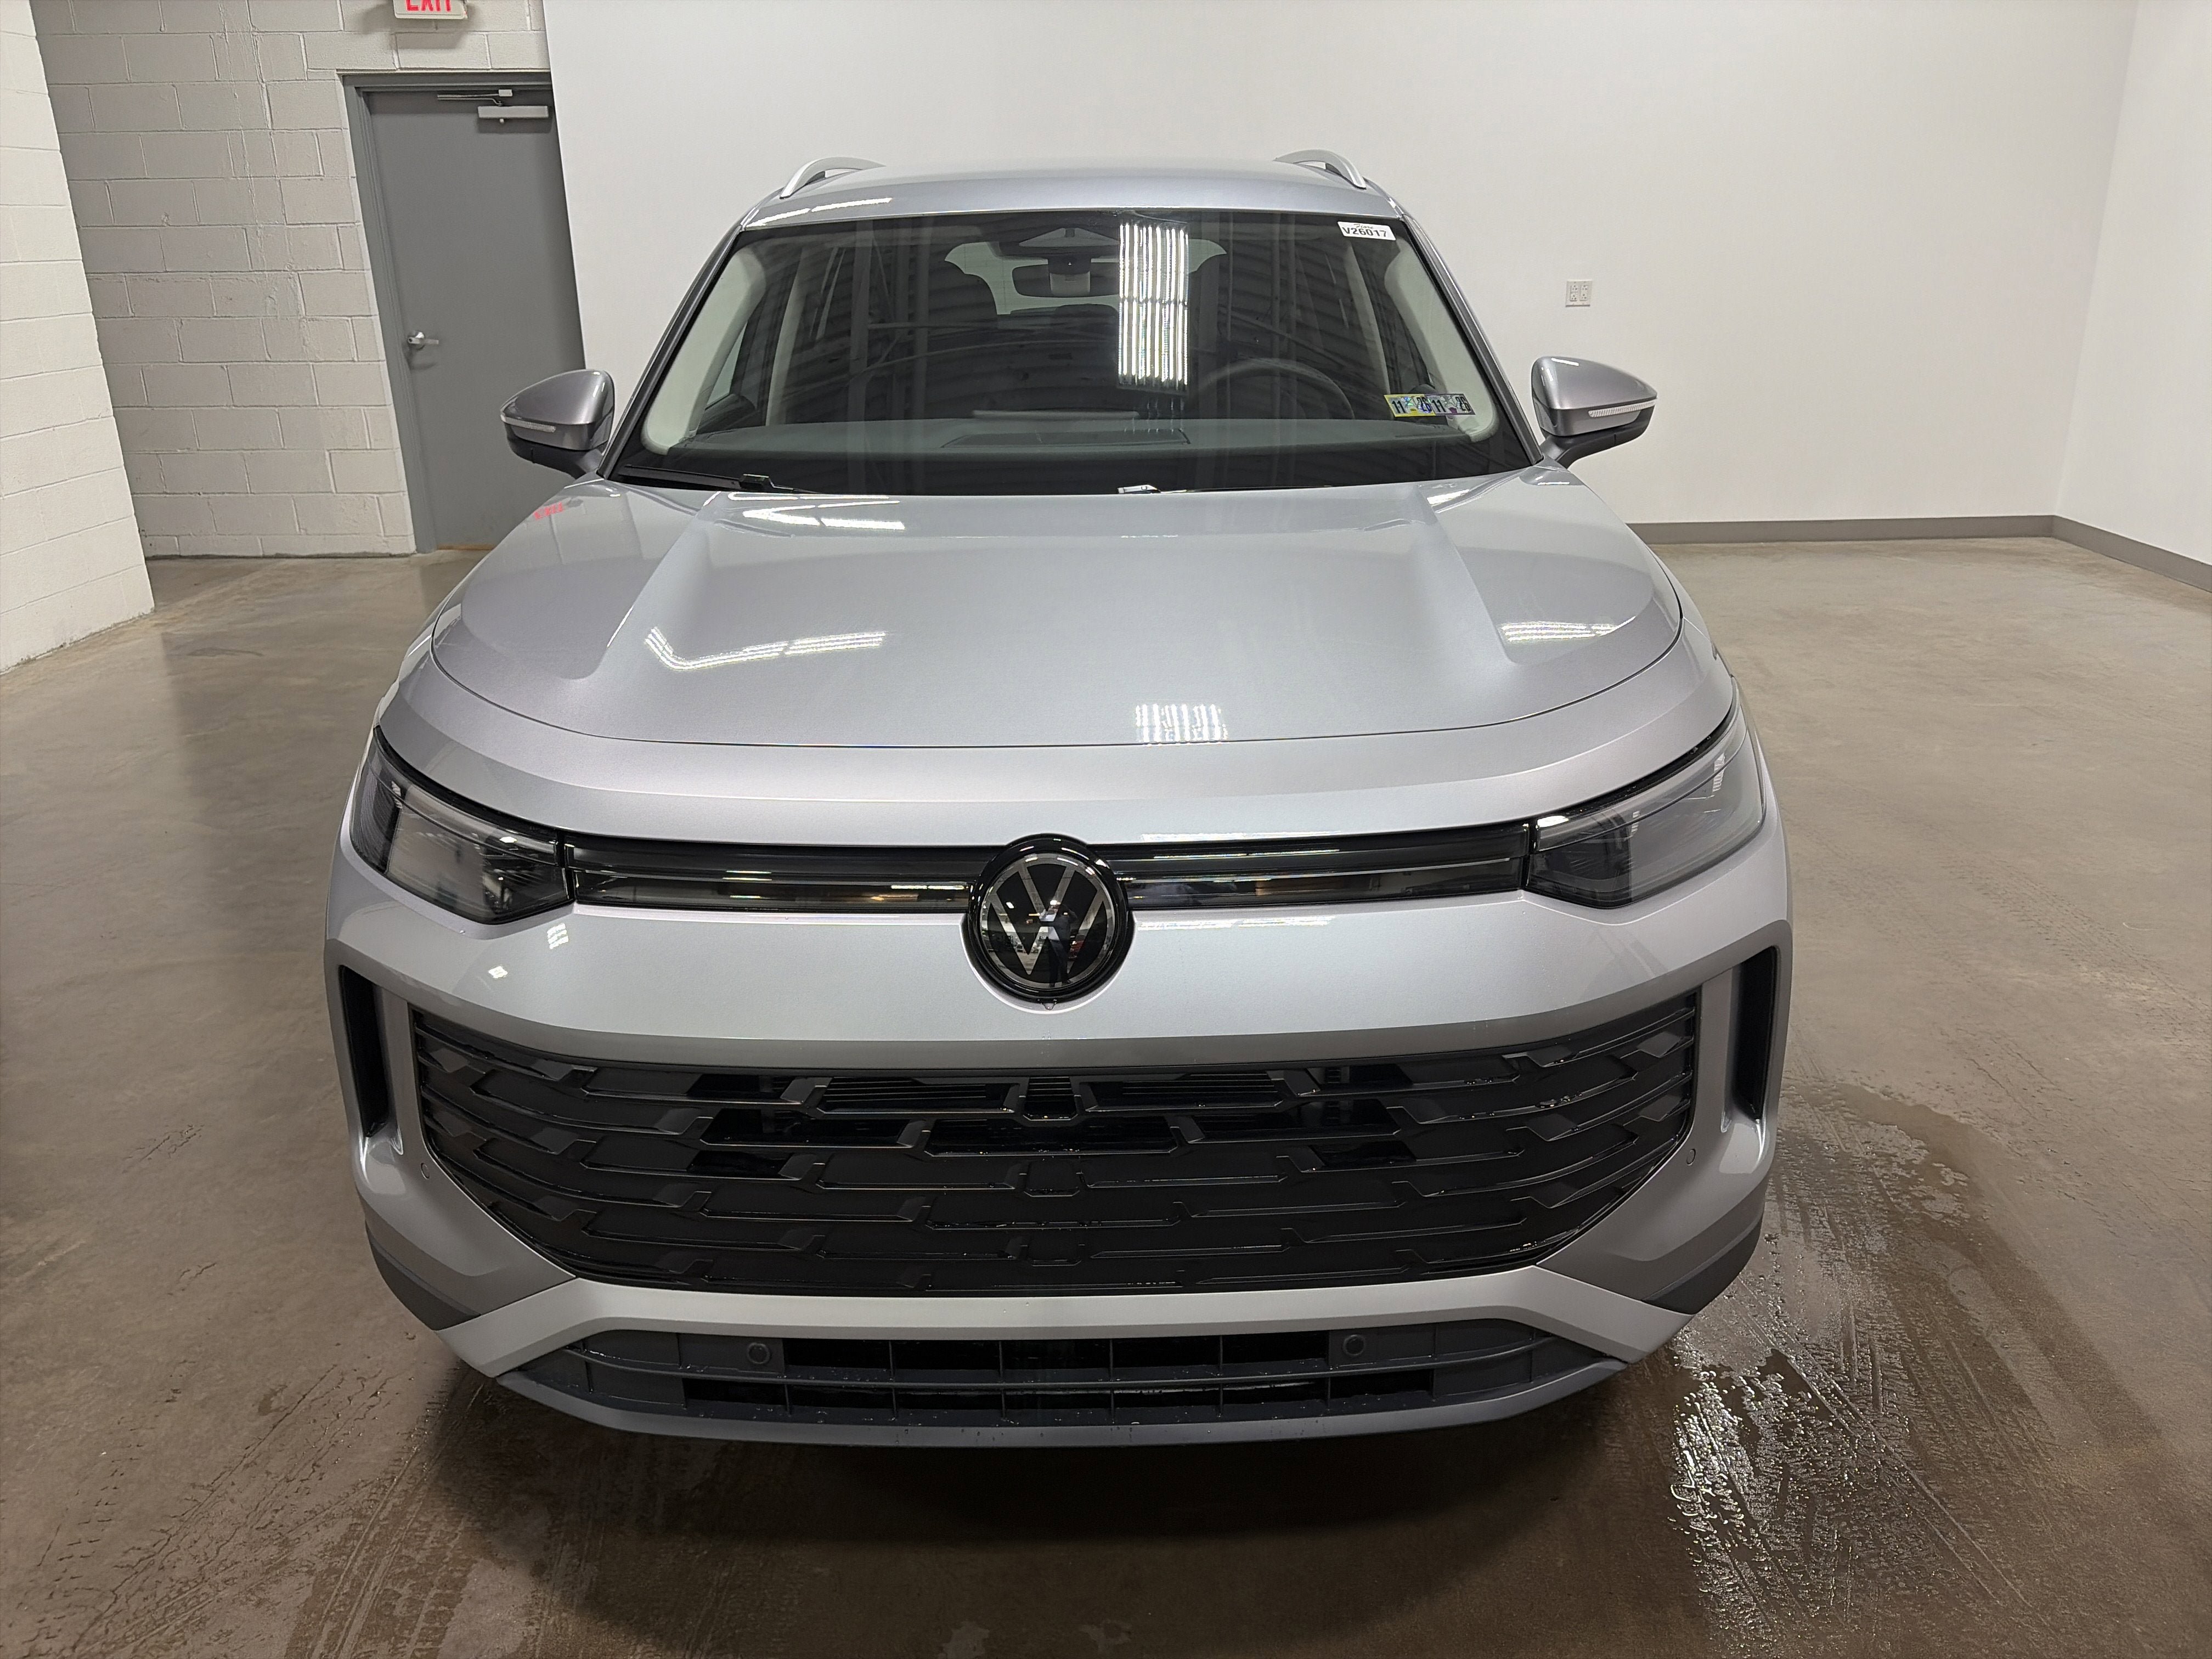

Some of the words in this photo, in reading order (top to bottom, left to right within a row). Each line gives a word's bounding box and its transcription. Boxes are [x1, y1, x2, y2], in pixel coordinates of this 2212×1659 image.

[1342, 227, 1386, 237] V26017
[1392, 399, 1406, 413] 11
[1417, 397, 1432, 412] 26
[1431, 399, 1446, 412] 11
[1455, 396, 1471, 411] 26
